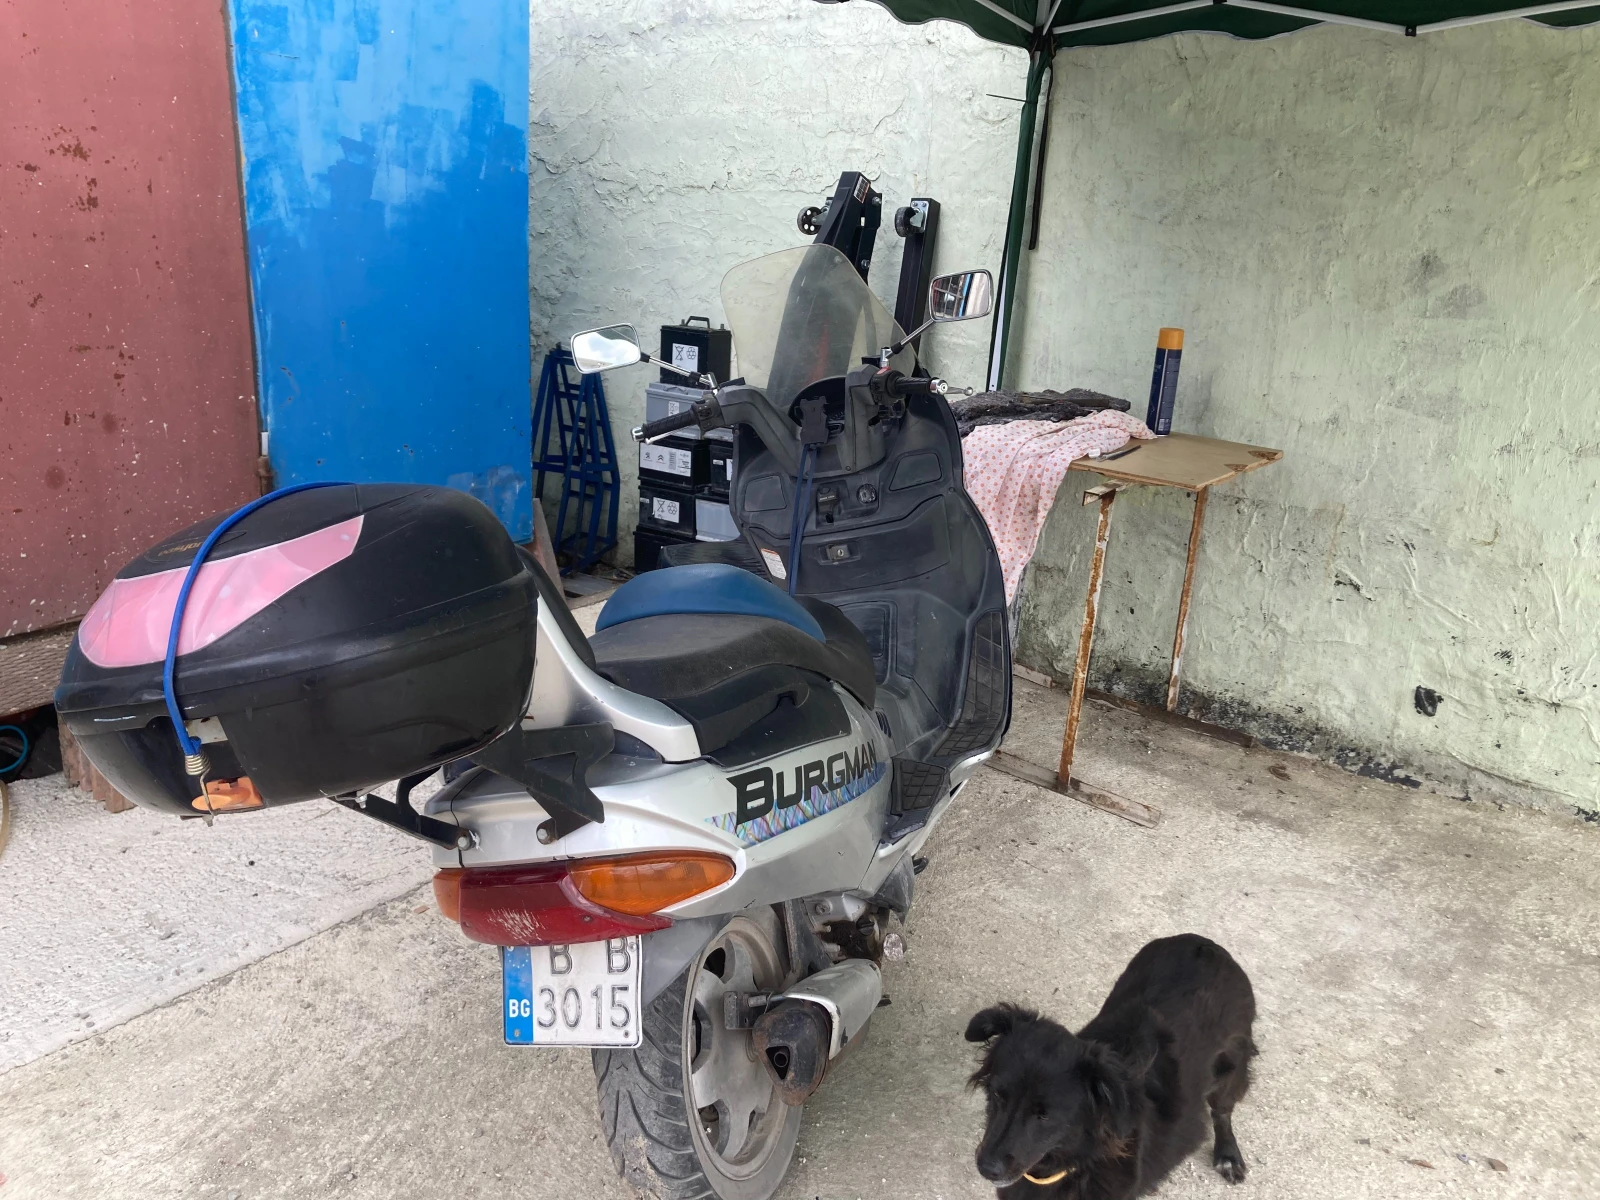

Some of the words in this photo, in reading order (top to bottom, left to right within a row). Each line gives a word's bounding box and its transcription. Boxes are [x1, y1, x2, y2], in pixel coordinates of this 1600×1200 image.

[726, 738, 877, 827] BURGMAN
[550, 945, 573, 975] B
[606, 938, 631, 974] B
[509, 998, 531, 1018] BG
[537, 985, 631, 1030] 3015
